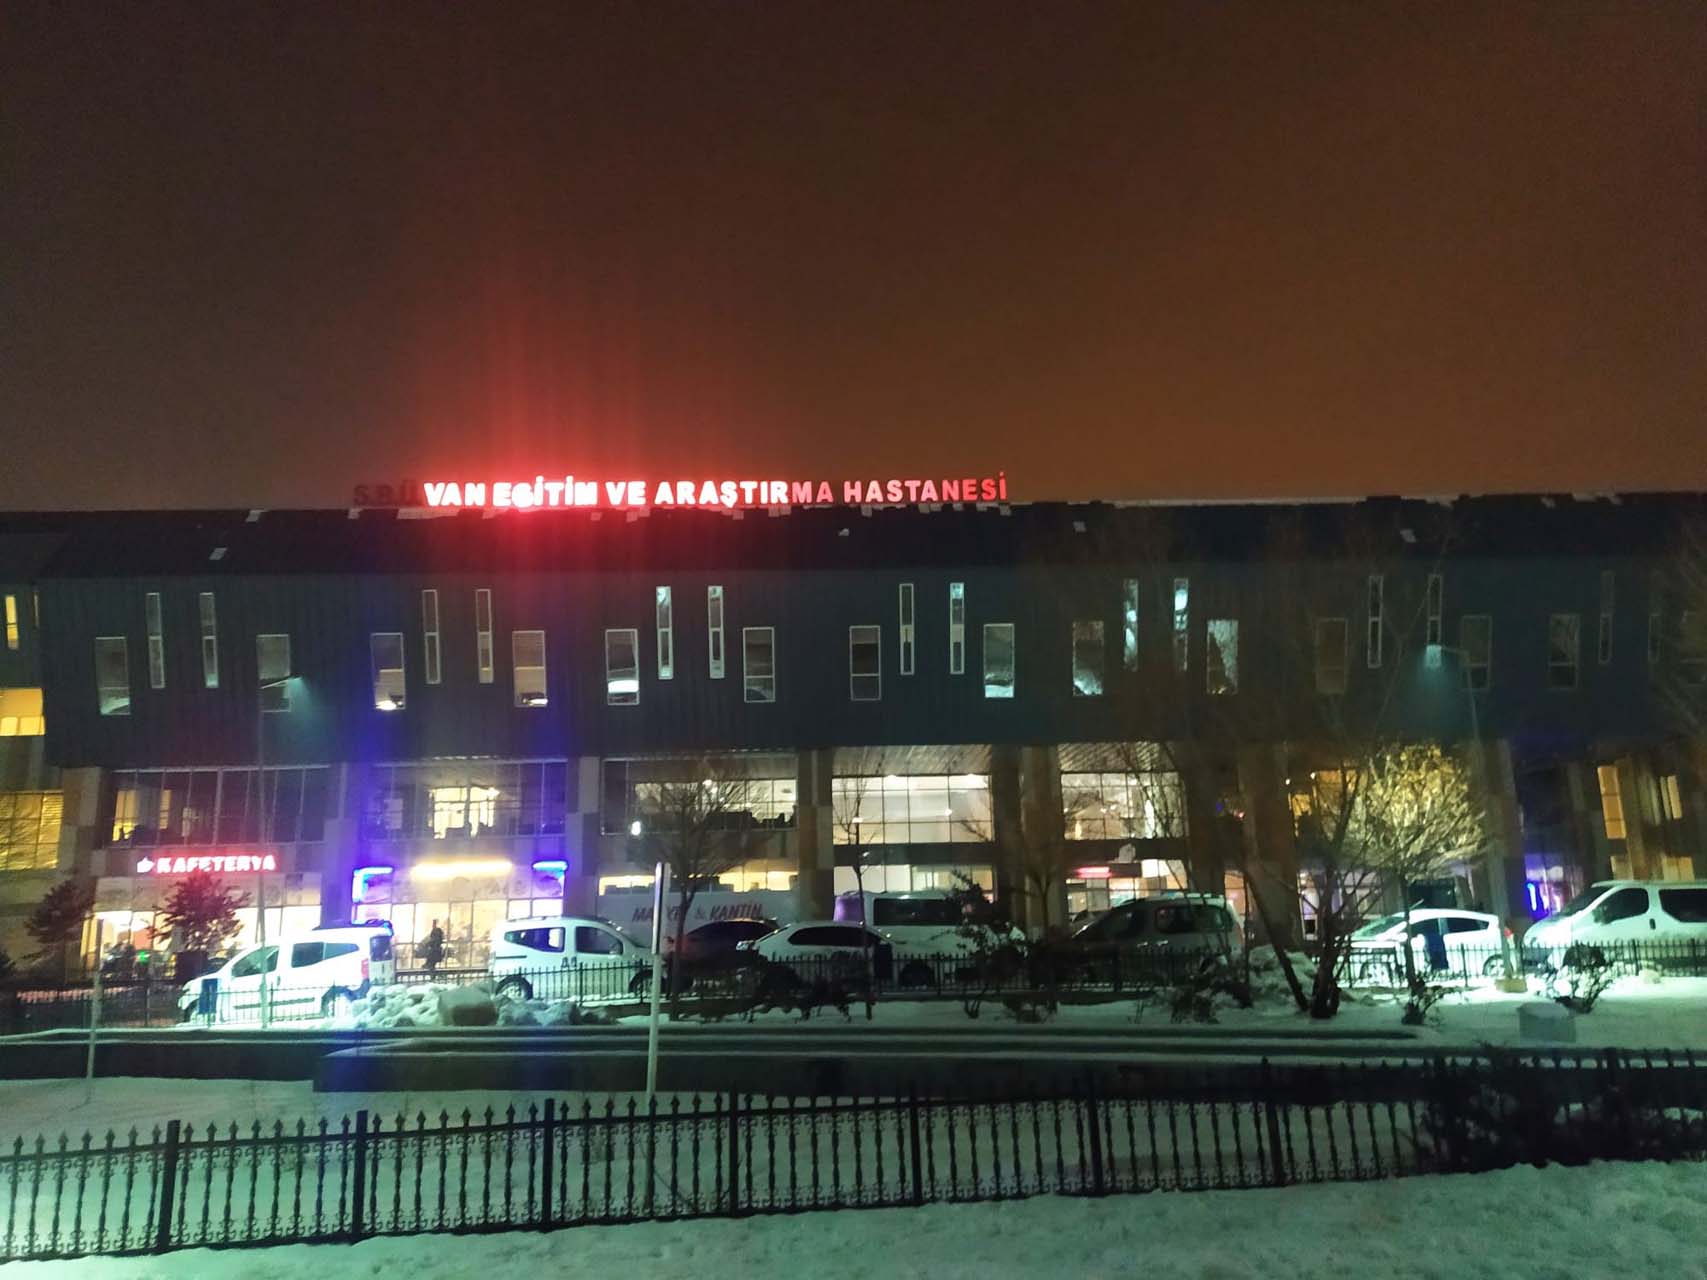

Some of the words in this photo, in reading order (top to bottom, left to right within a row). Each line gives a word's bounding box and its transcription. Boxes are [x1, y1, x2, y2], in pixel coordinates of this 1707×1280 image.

[423, 482, 486, 506] VAN
[605, 481, 646, 506] VE
[653, 480, 833, 507] ARAŞTIRMA
[843, 473, 1006, 503] HASTANESİ
[156, 855, 276, 873] KAFETERYA
